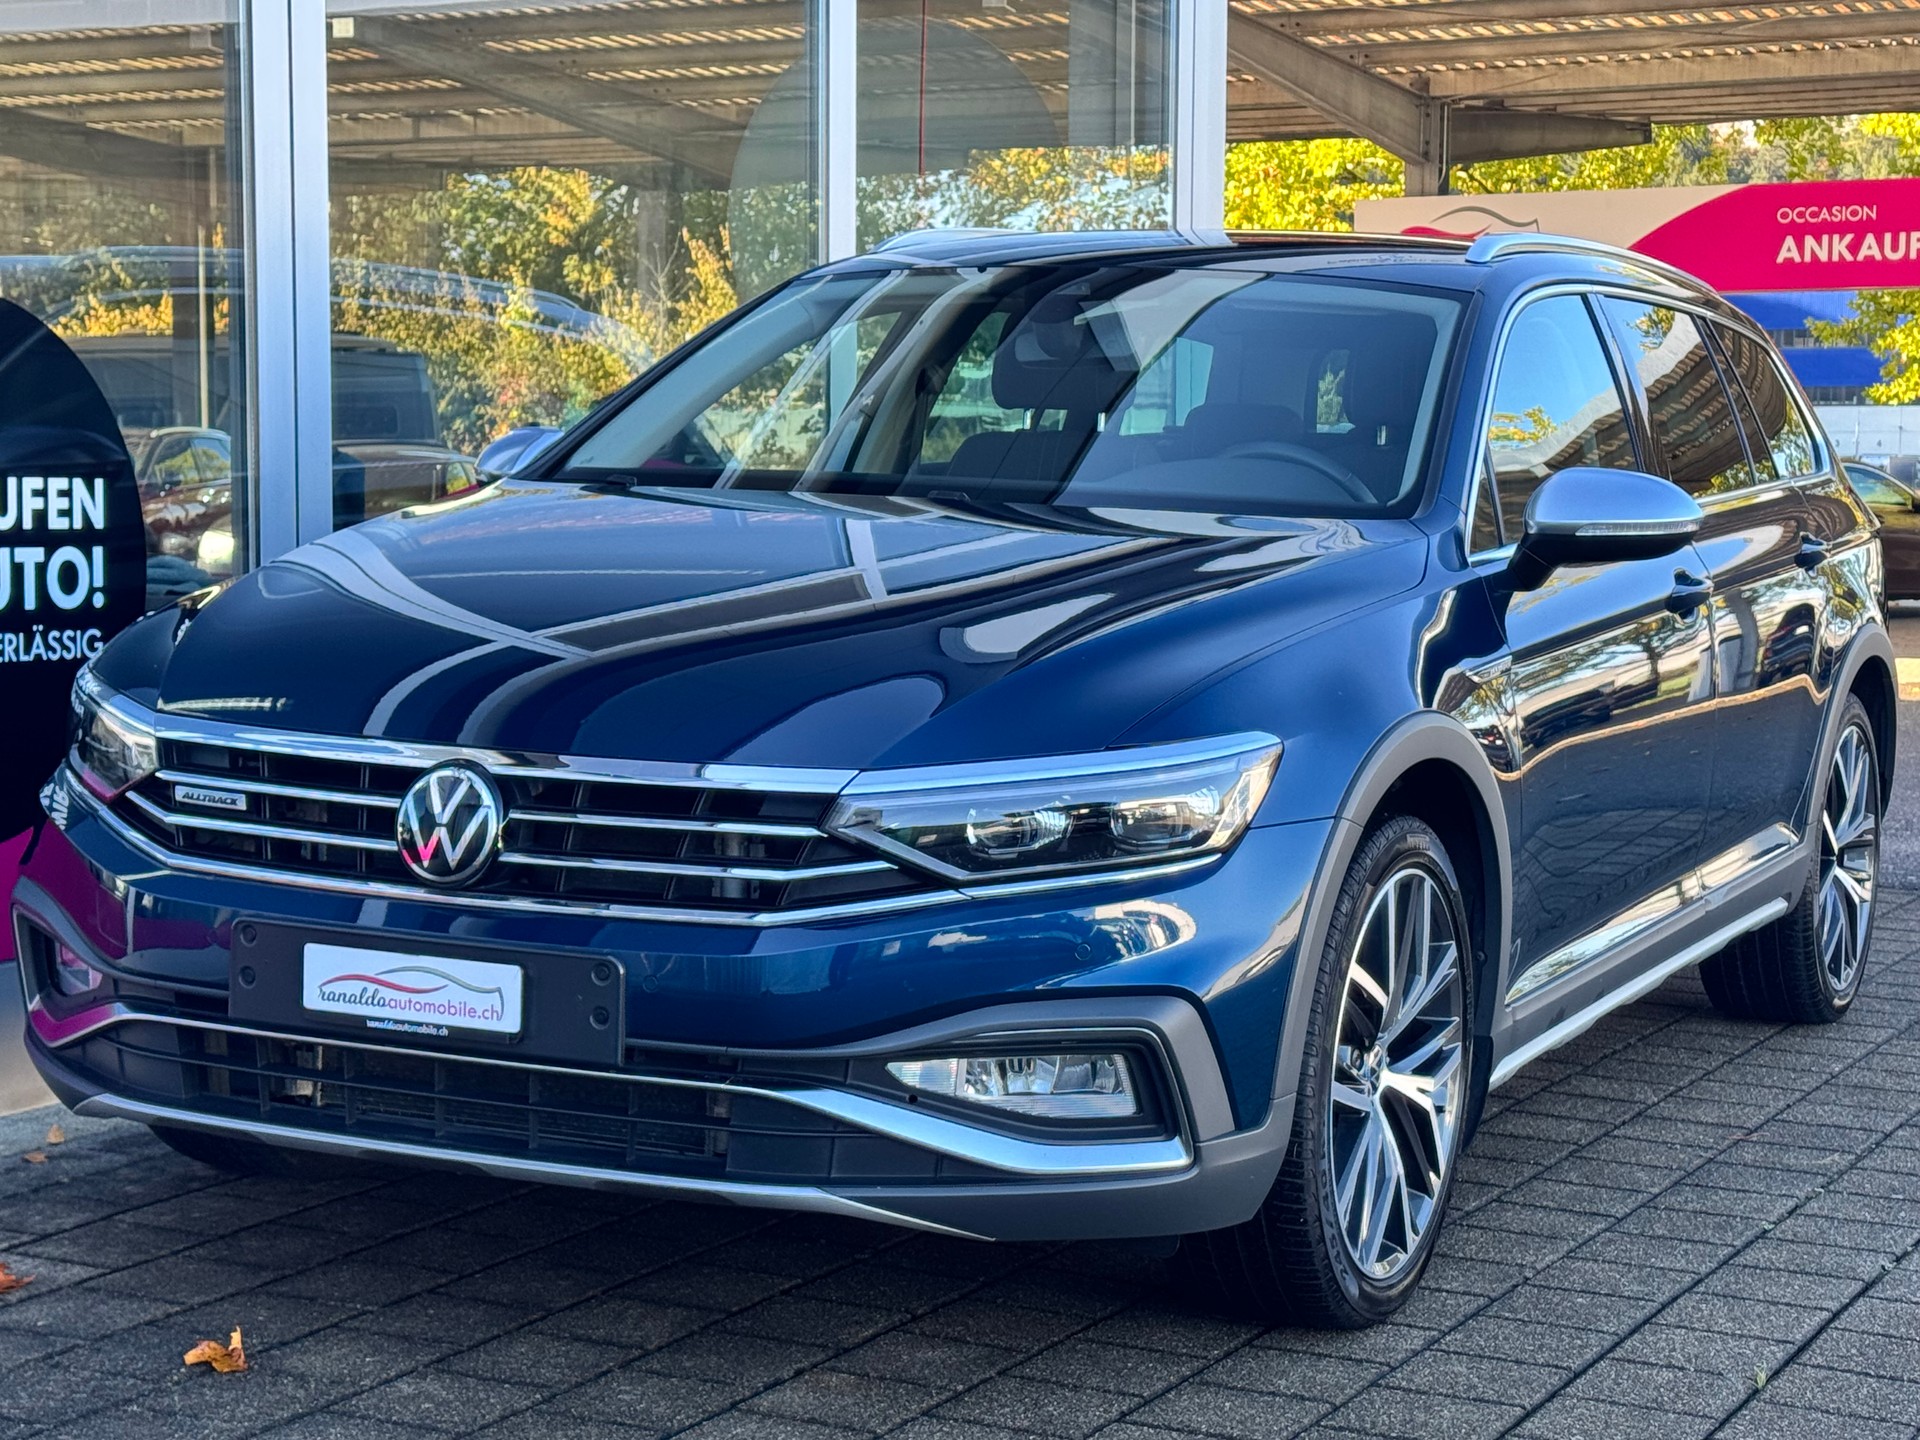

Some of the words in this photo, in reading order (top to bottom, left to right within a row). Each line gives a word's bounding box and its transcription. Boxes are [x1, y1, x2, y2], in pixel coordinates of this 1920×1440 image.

[1776, 204, 1877, 224] OCCASION
[1775, 230, 1920, 264] ANKAUF
[0, 624, 104, 663] RLÄSSIG
[181, 791, 239, 806] ALLTRACK
[318, 985, 502, 1022] ranaldoautomobile.ch
